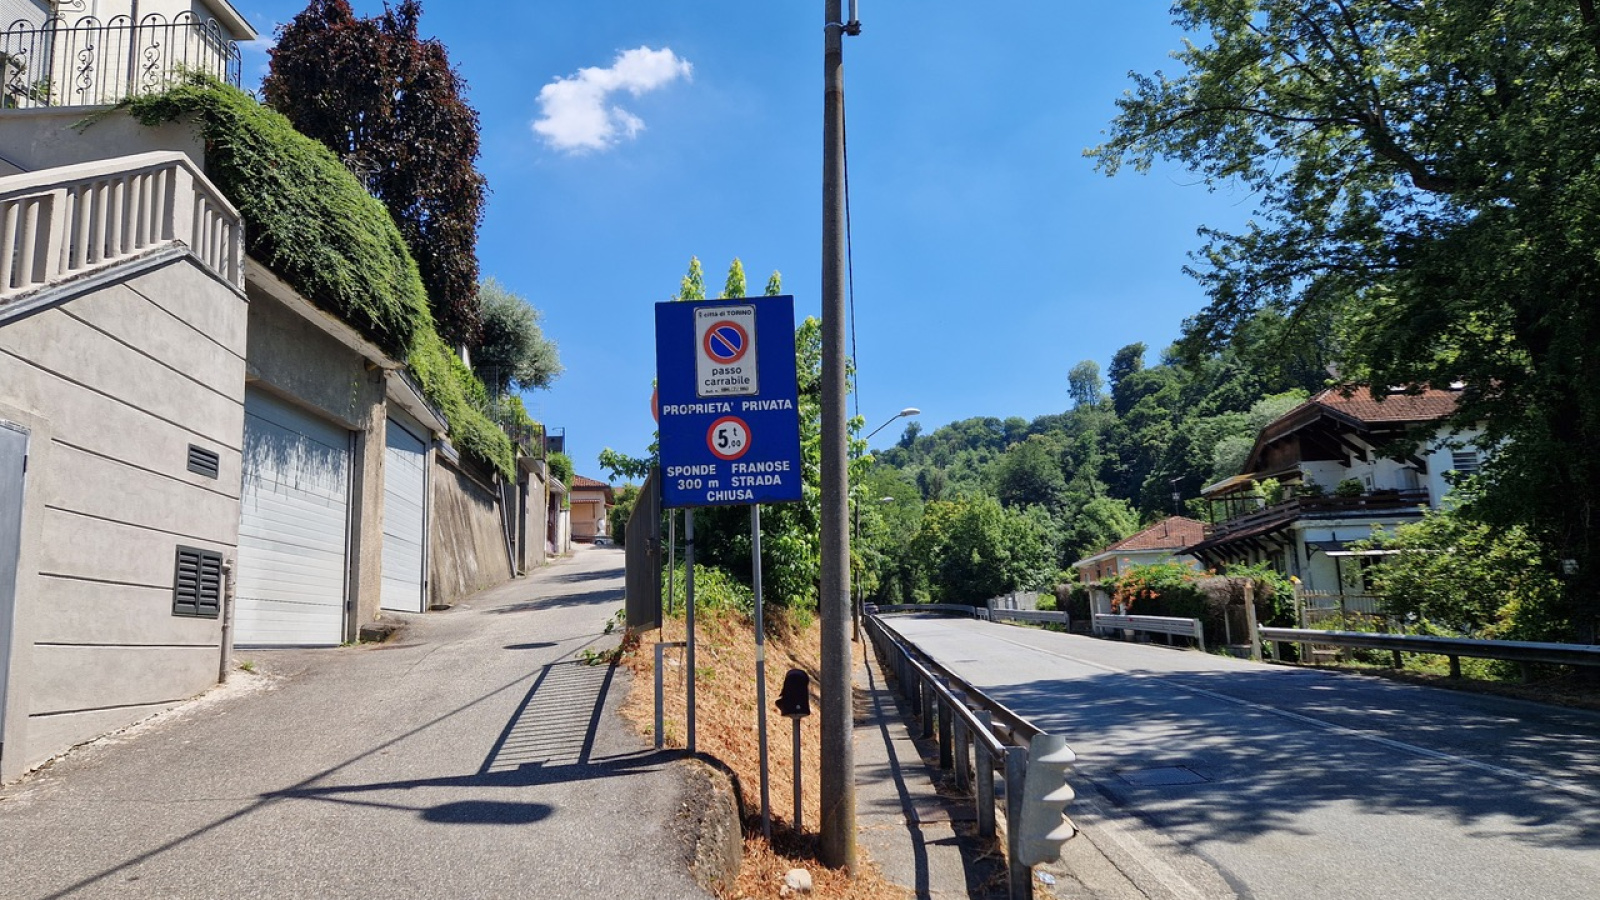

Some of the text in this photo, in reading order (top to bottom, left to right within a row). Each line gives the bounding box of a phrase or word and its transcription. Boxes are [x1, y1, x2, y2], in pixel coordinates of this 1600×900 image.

[712, 367, 742, 376] passo
[704, 376, 750, 386] carrabile
[663, 399, 793, 415] PROPRIETA' PRIVATA
[667, 460, 790, 477] SPONDE FRANOSE
[677, 474, 782, 490] 300 m STRADA
[706, 489, 754, 502] CHIUSA
